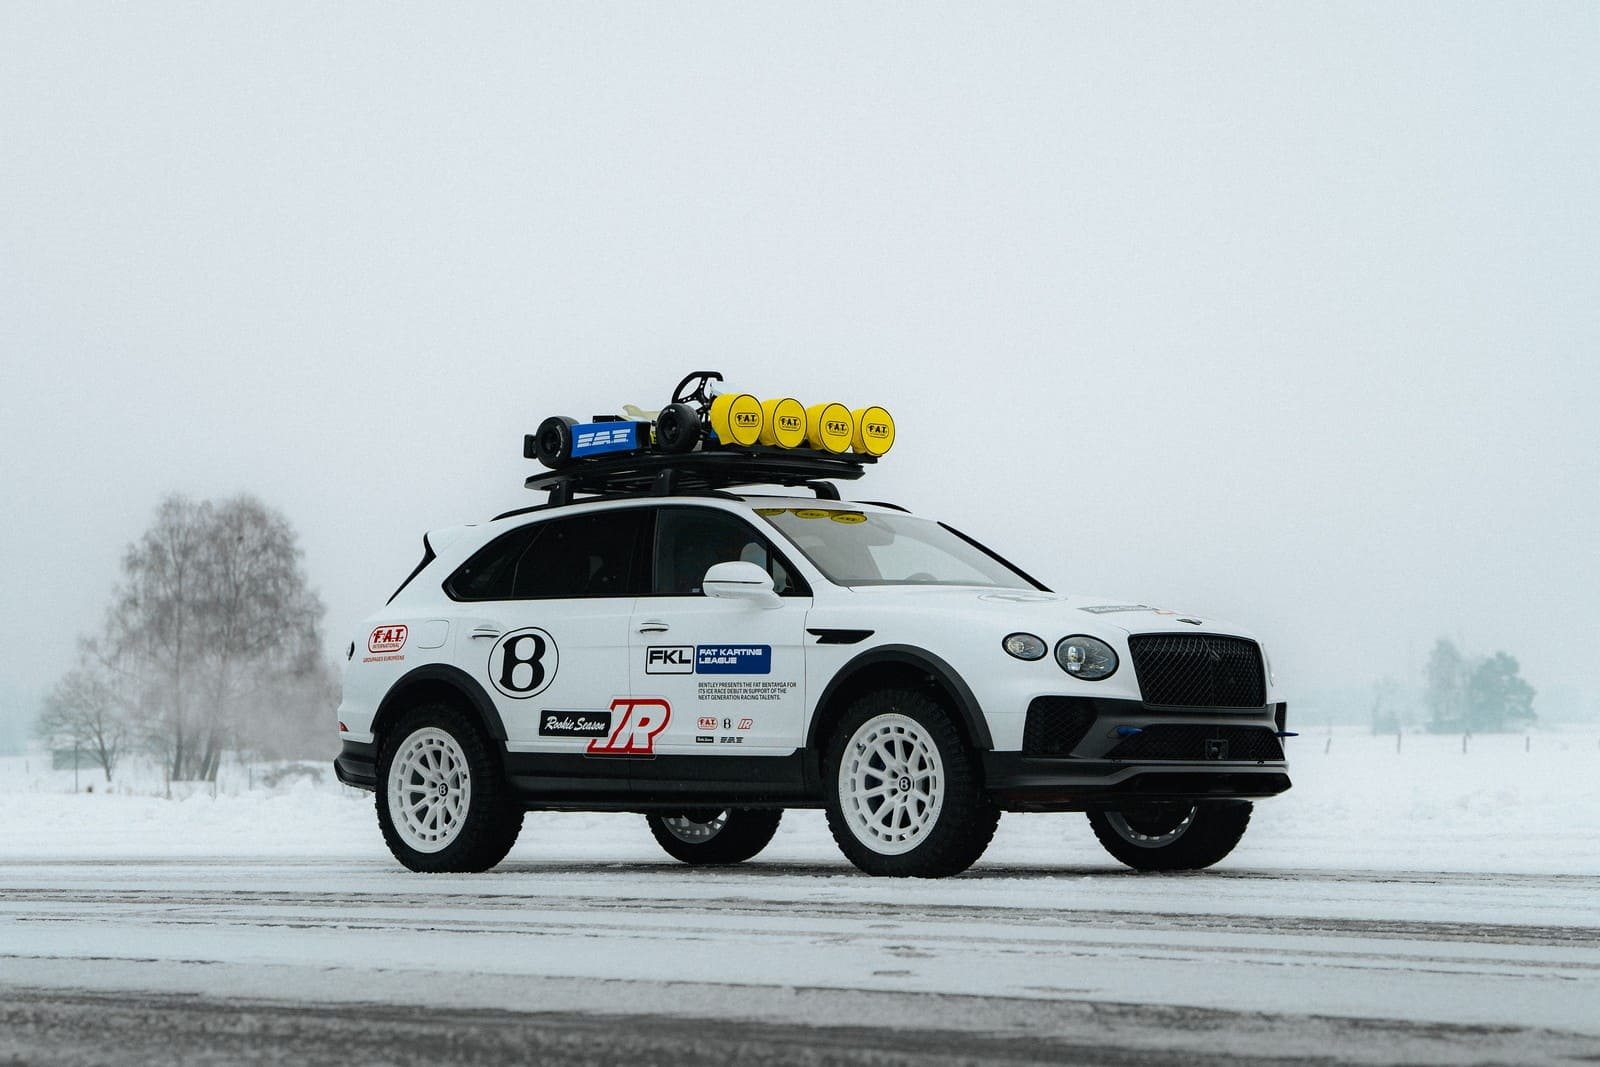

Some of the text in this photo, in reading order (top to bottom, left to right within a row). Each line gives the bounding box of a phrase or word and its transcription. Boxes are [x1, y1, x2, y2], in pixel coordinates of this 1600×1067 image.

[649, 650, 692, 664] FKL
[699, 648, 763, 656] FAT KARTING
[544, 715, 606, 731] Rookie Season
